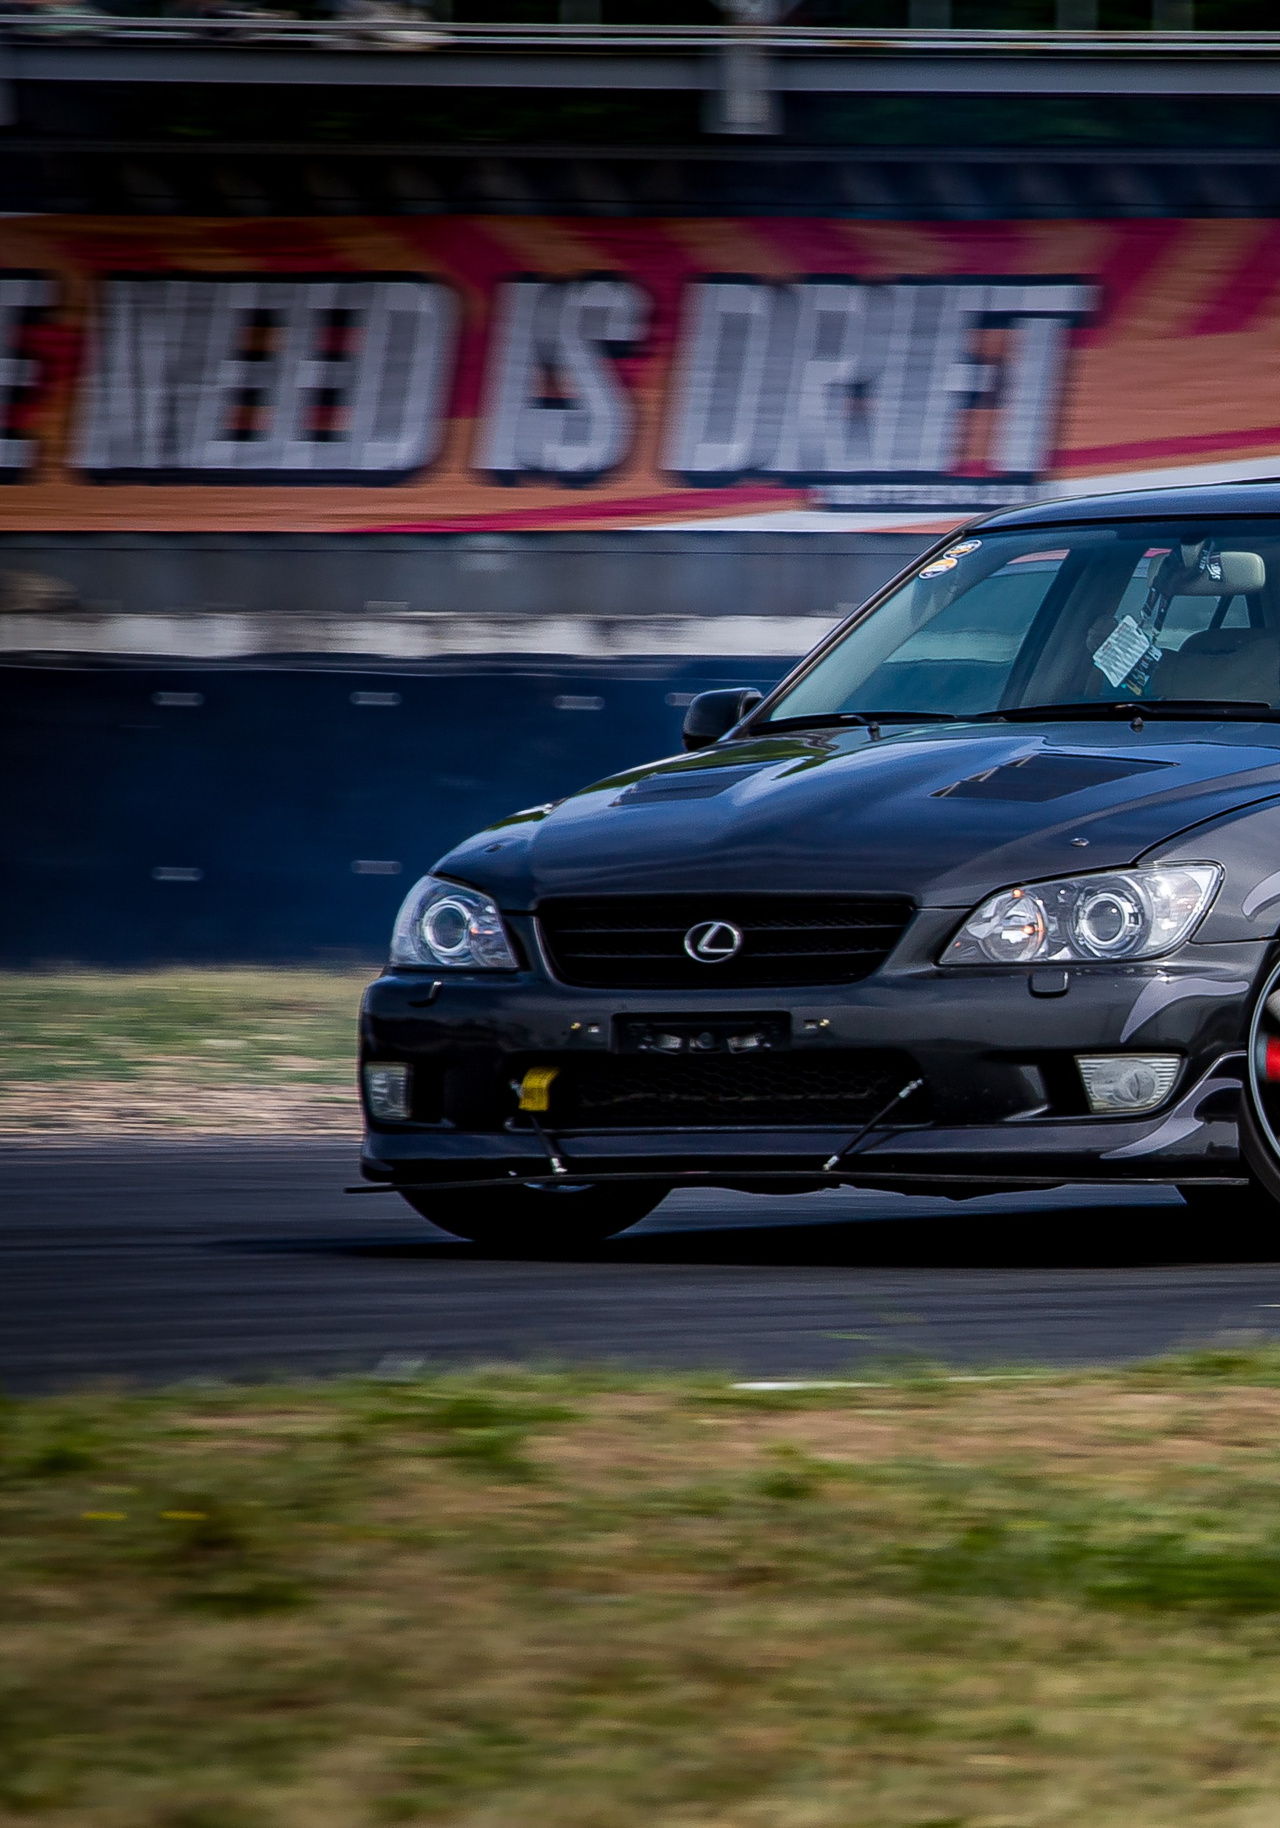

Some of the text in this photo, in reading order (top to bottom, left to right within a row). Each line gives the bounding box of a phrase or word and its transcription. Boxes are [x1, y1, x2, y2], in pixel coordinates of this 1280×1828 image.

[67, 278, 463, 471] NEED
[471, 279, 655, 472] IS
[657, 282, 1104, 473] DRIFT
